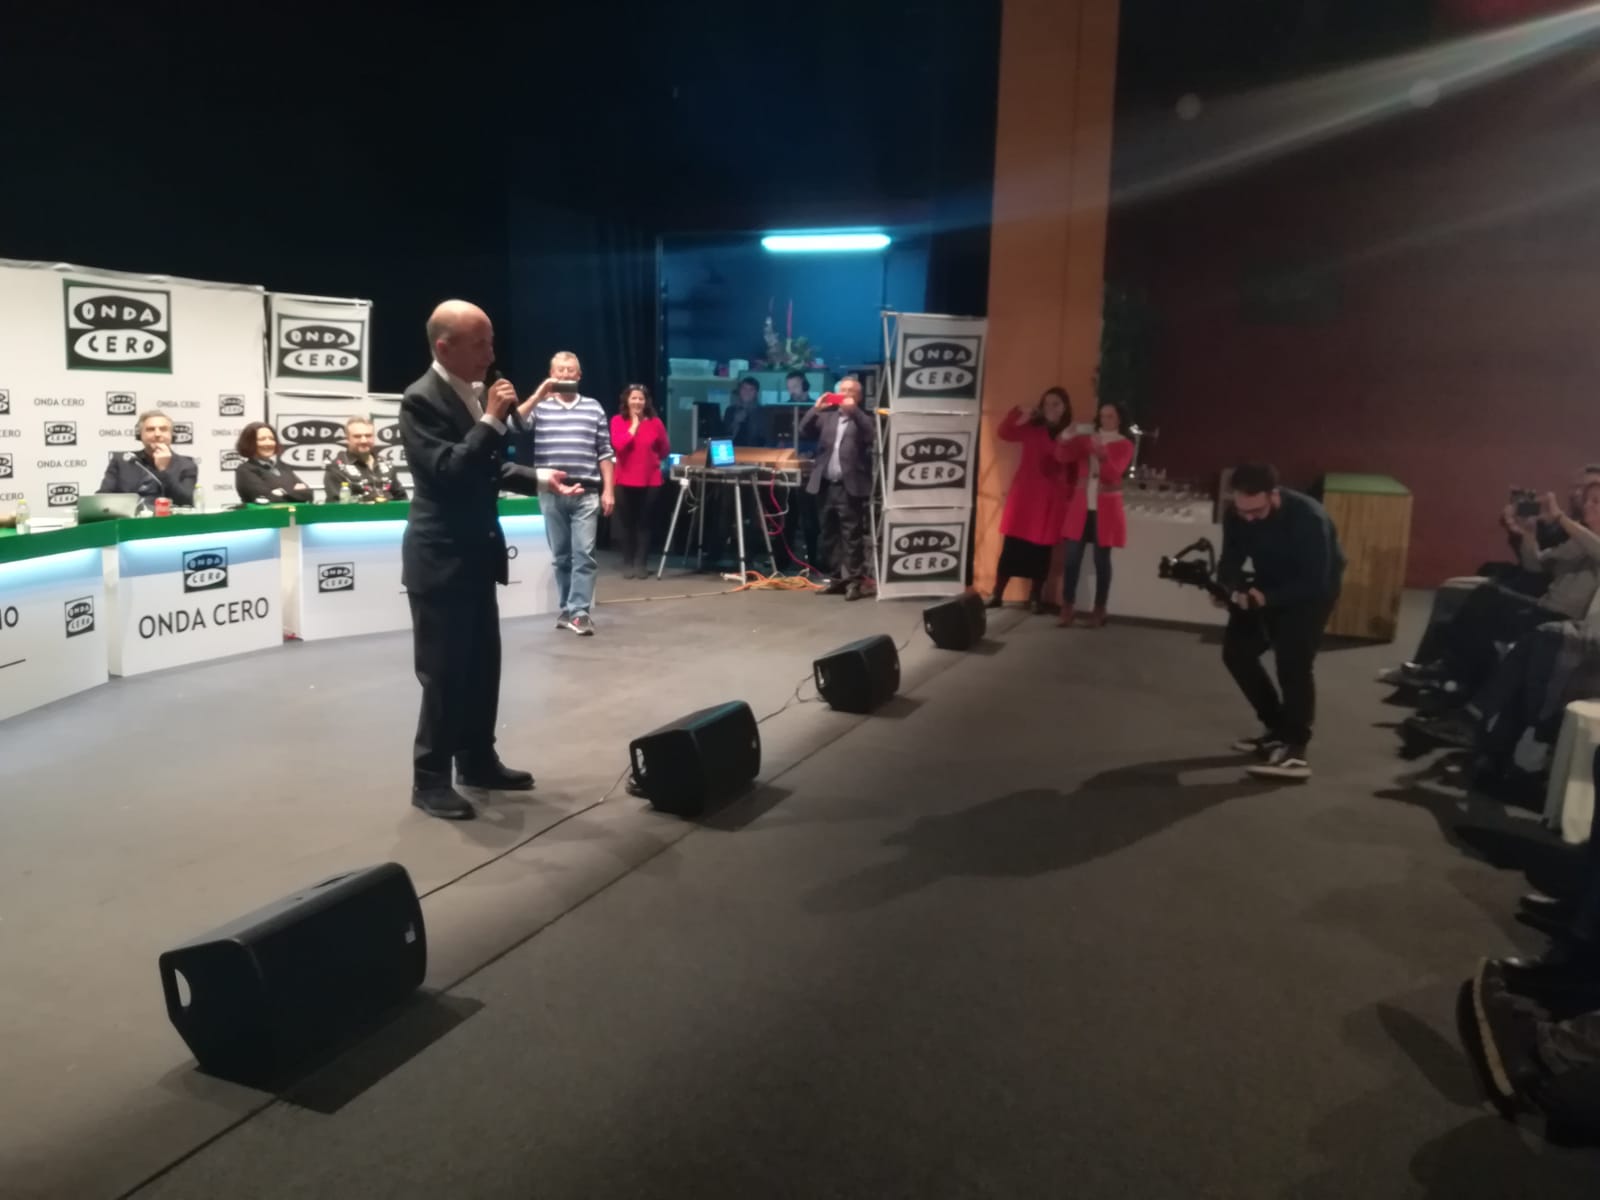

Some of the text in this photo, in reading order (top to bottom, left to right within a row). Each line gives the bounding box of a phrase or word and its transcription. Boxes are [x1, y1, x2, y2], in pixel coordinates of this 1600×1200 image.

[82, 302, 154, 323] ONDA
[290, 330, 350, 344] ONDA
[88, 335, 154, 354] CERO
[294, 353, 350, 367] CERO
[914, 348, 967, 361] ONDA
[916, 371, 965, 385] CERO
[33, 398, 85, 407] ONDA CERO
[287, 426, 346, 438] ONDA
[291, 449, 333, 462] CER
[905, 444, 958, 457] ONDA
[36, 459, 87, 469] ONDA CERO
[908, 466, 956, 480] CERO
[900, 535, 951, 549] ONDA
[189, 557, 220, 568] ONDA
[902, 557, 950, 570] CERO
[192, 571, 221, 584] CERO
[138, 597, 269, 639] ONDA CERO
